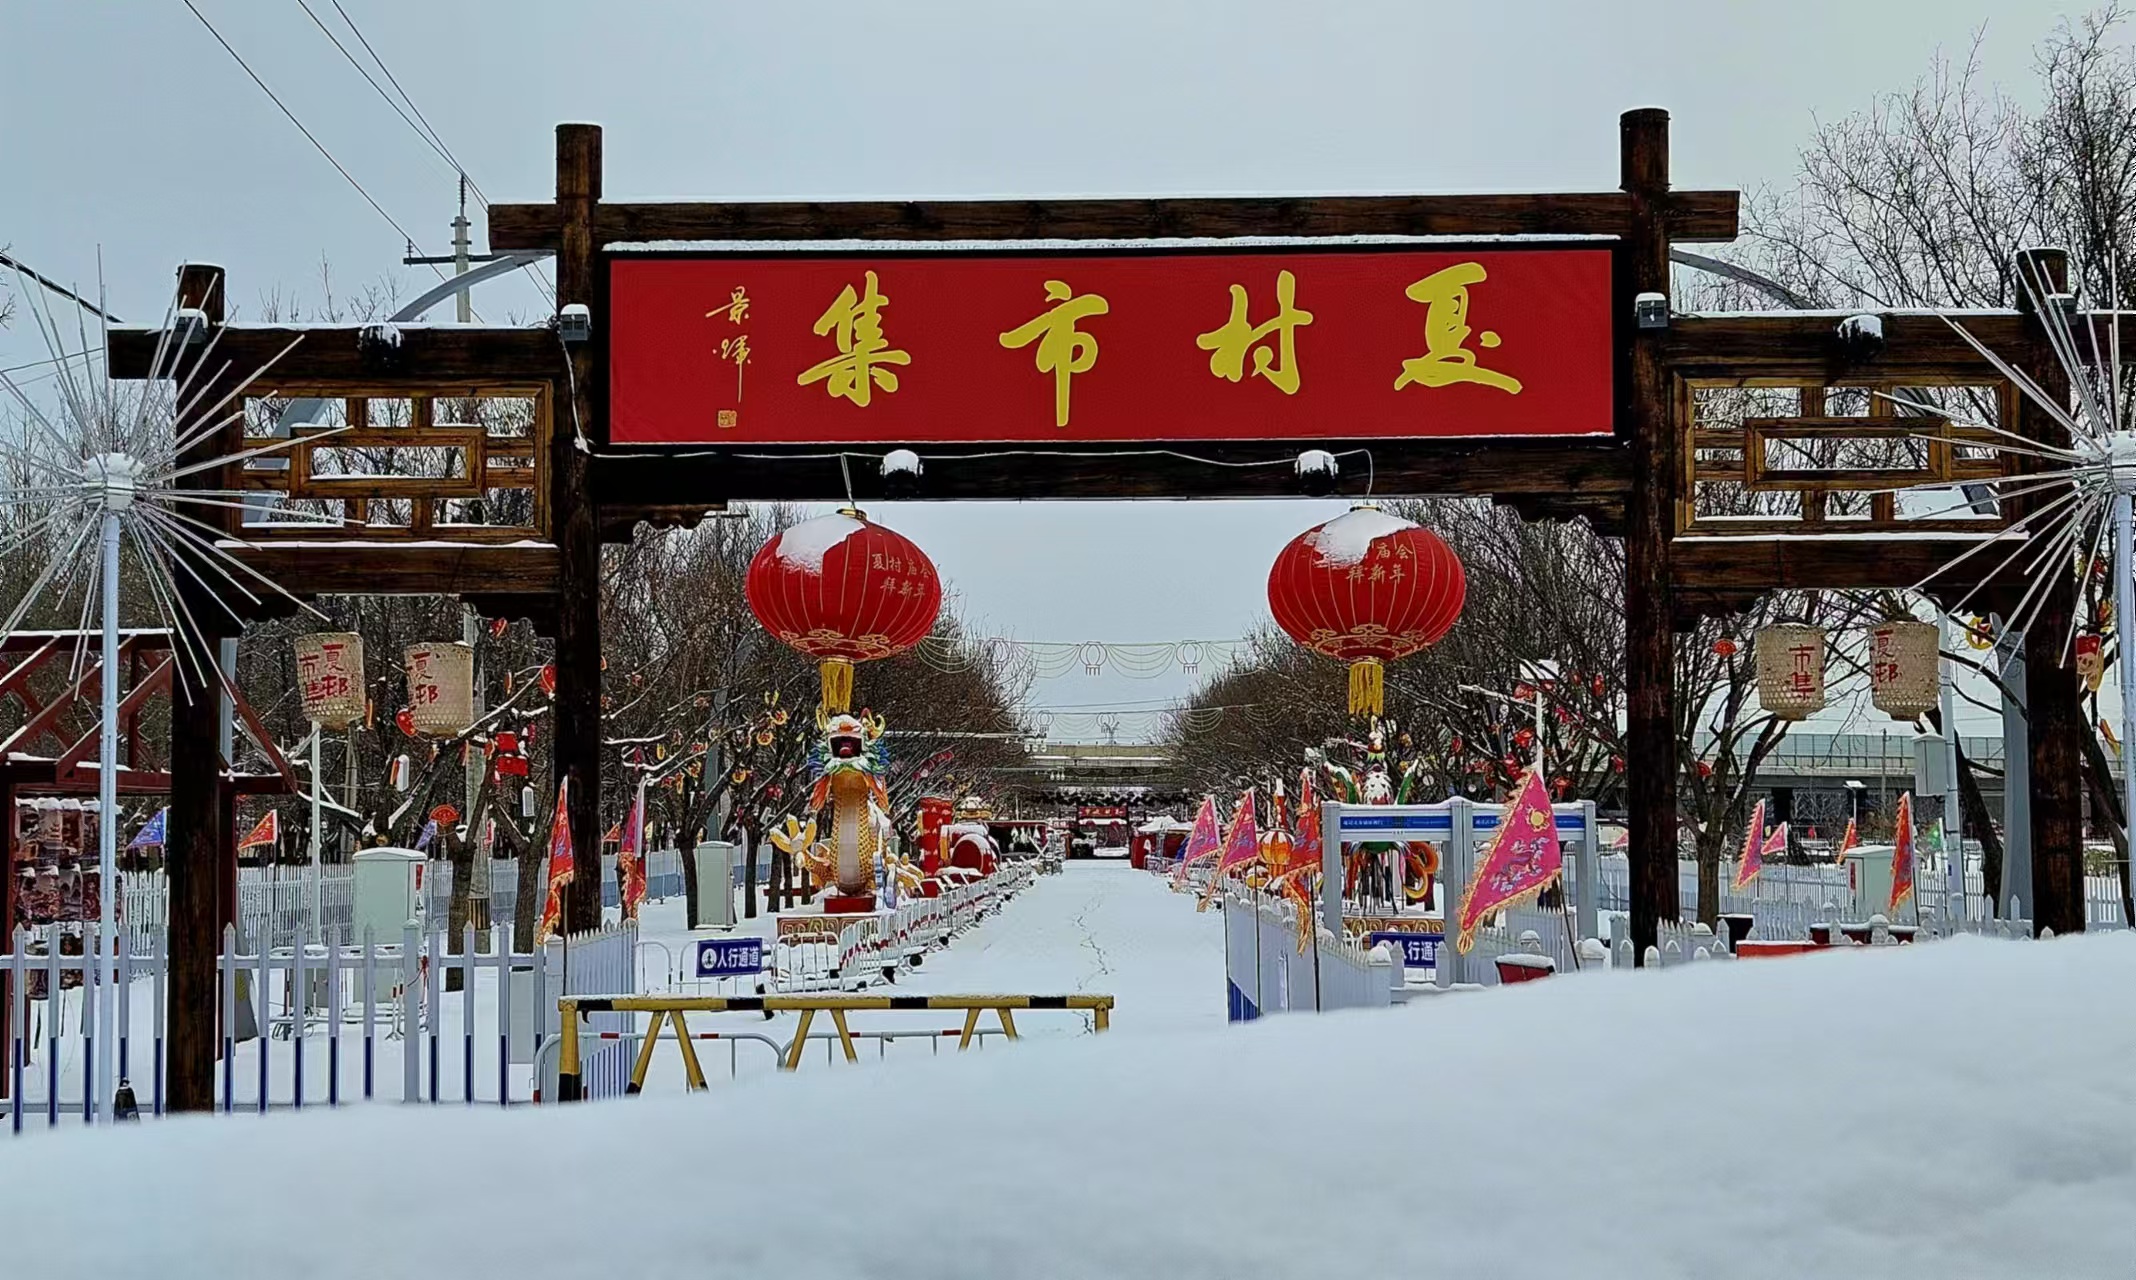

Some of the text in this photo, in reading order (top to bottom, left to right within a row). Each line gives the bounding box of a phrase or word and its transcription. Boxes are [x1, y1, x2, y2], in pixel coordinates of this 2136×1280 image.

[1376, 542, 1414, 560] 庙会
[717, 946, 759, 968] 人行通道
